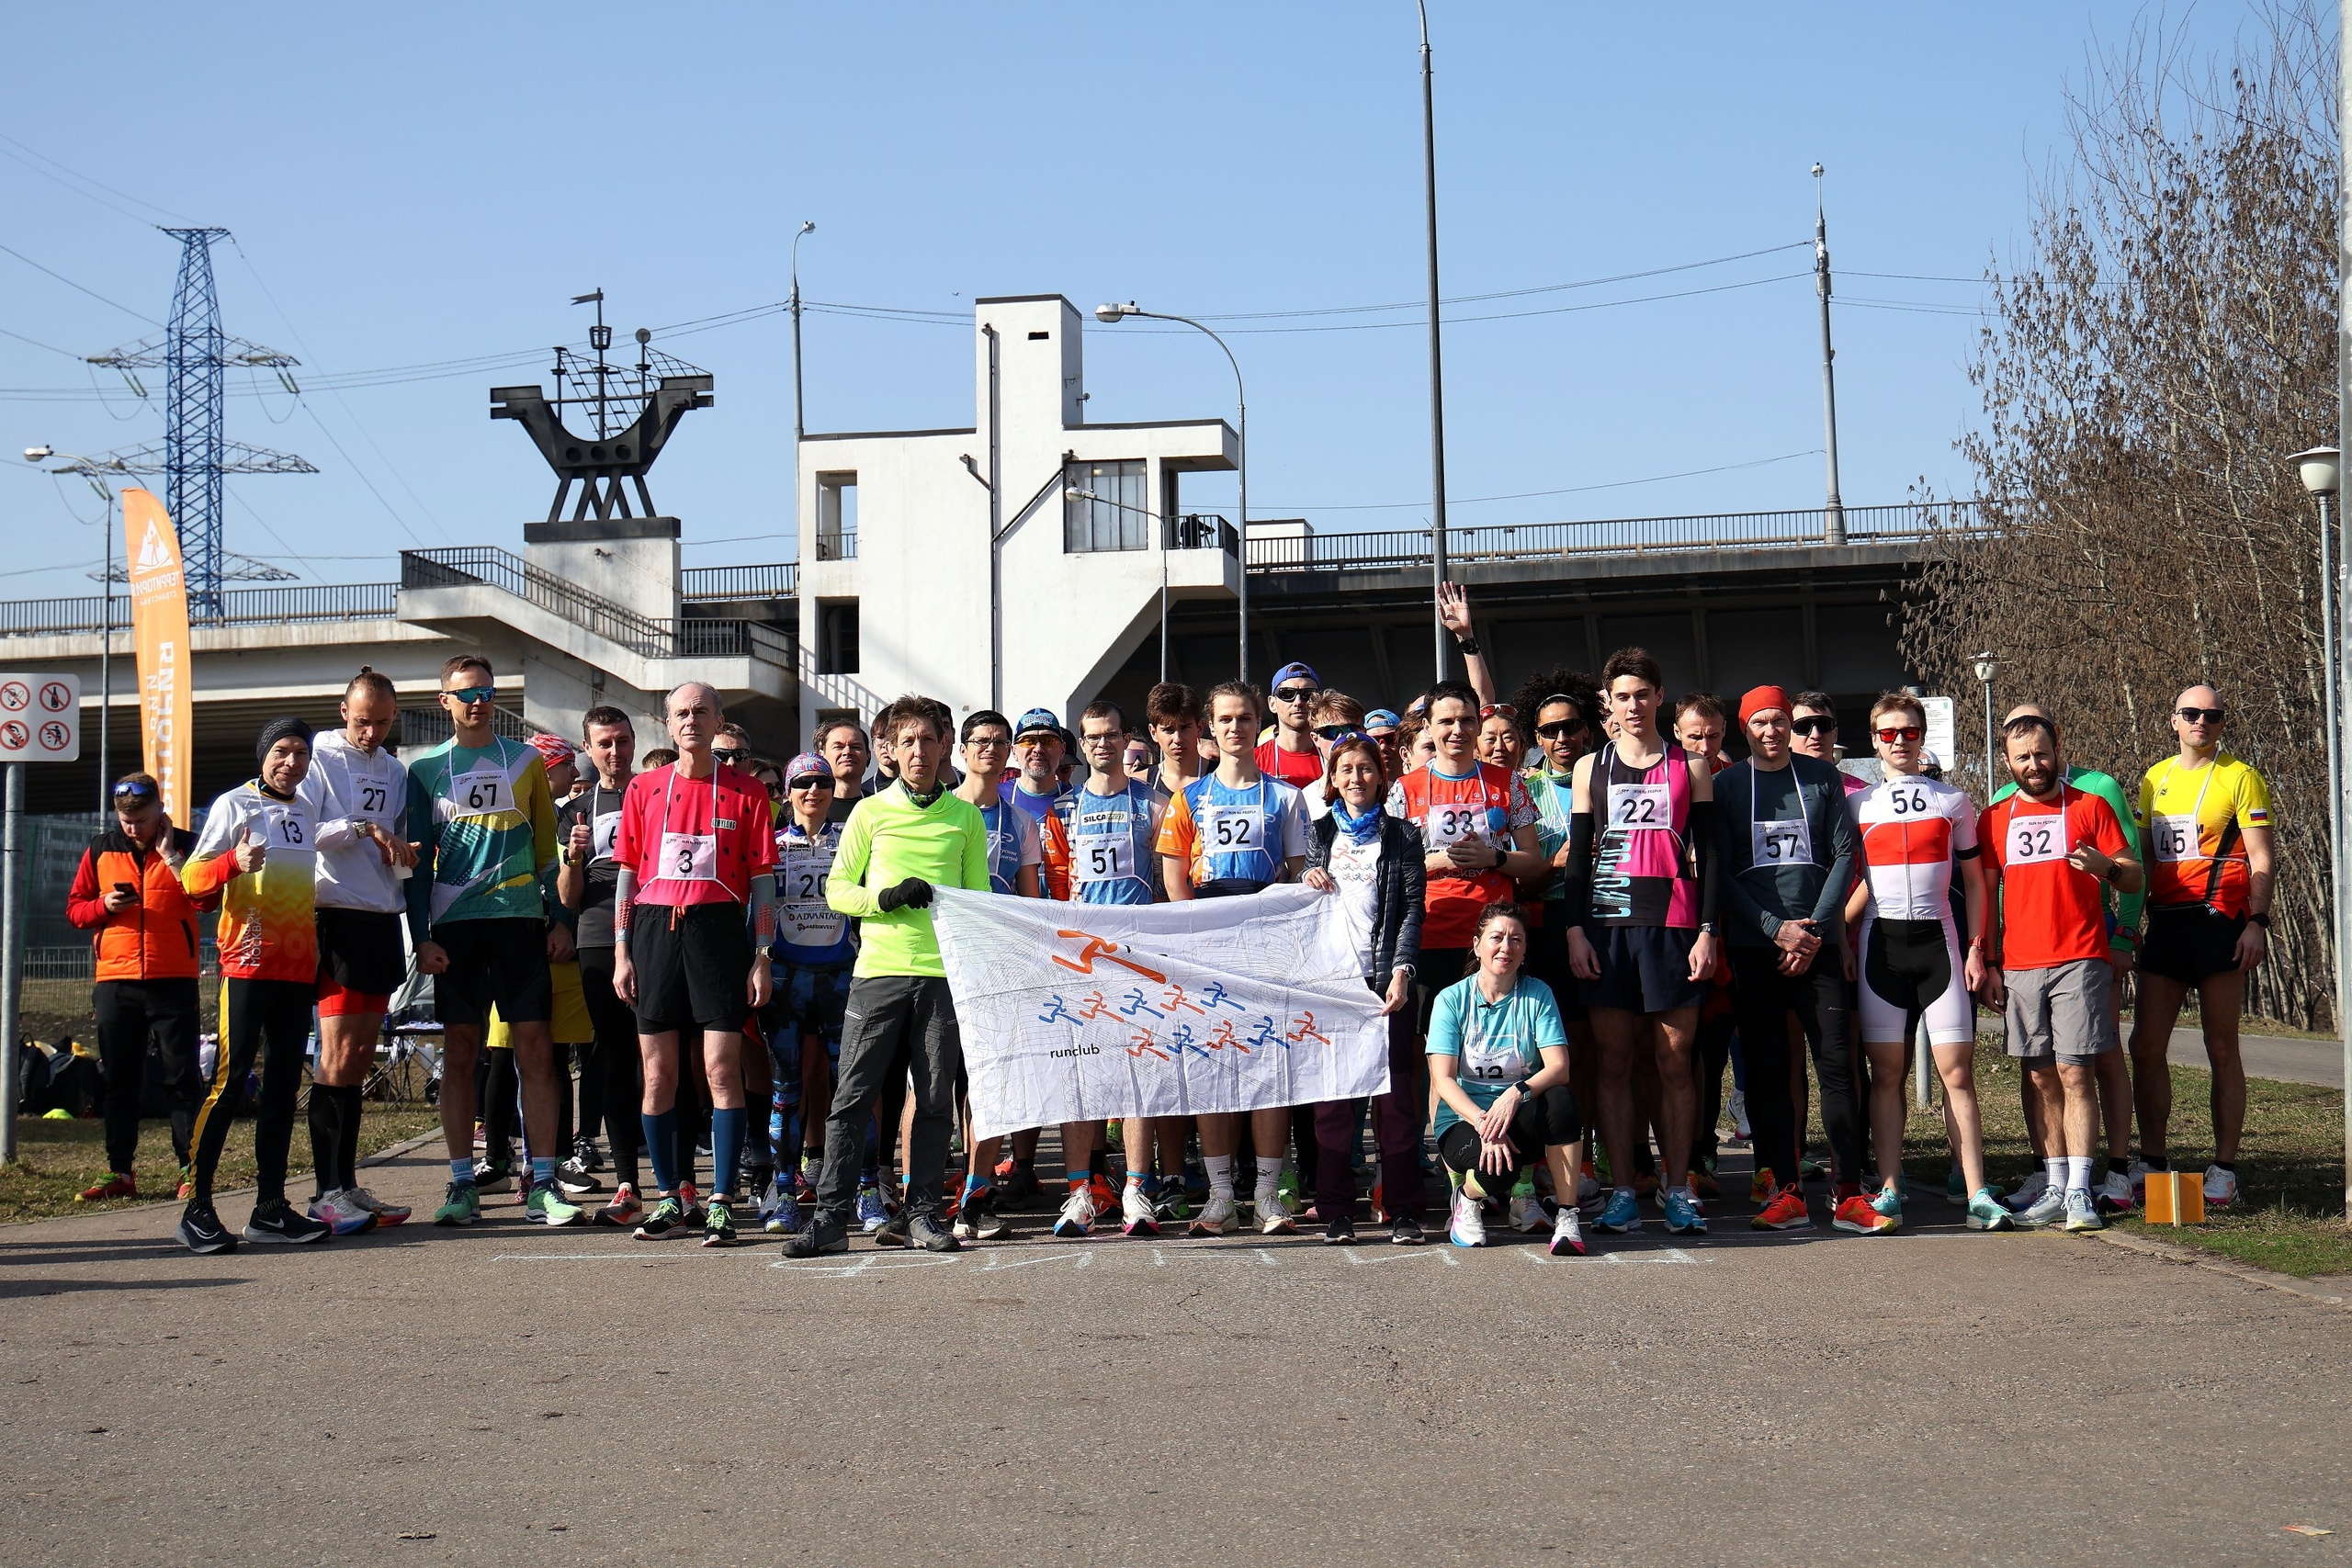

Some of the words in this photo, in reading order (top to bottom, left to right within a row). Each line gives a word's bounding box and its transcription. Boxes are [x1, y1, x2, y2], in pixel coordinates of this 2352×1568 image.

[362, 788, 386, 812] 27
[469, 784, 497, 809] 67
[1891, 789, 1927, 814] 56
[1084, 814, 1106, 823] SILCA
[1442, 810, 1475, 835] 33
[1622, 799, 1655, 823] 22
[280, 820, 303, 844] 13
[1217, 819, 1250, 845] 52
[2018, 830, 2052, 857] 32
[2160, 829, 2185, 855] 45
[1766, 834, 1798, 858] 57
[679, 849, 693, 873] 3
[1091, 847, 1118, 874] 51
[249, 917, 263, 967] МОСКВА
[1050, 1043, 1100, 1059] runclub
